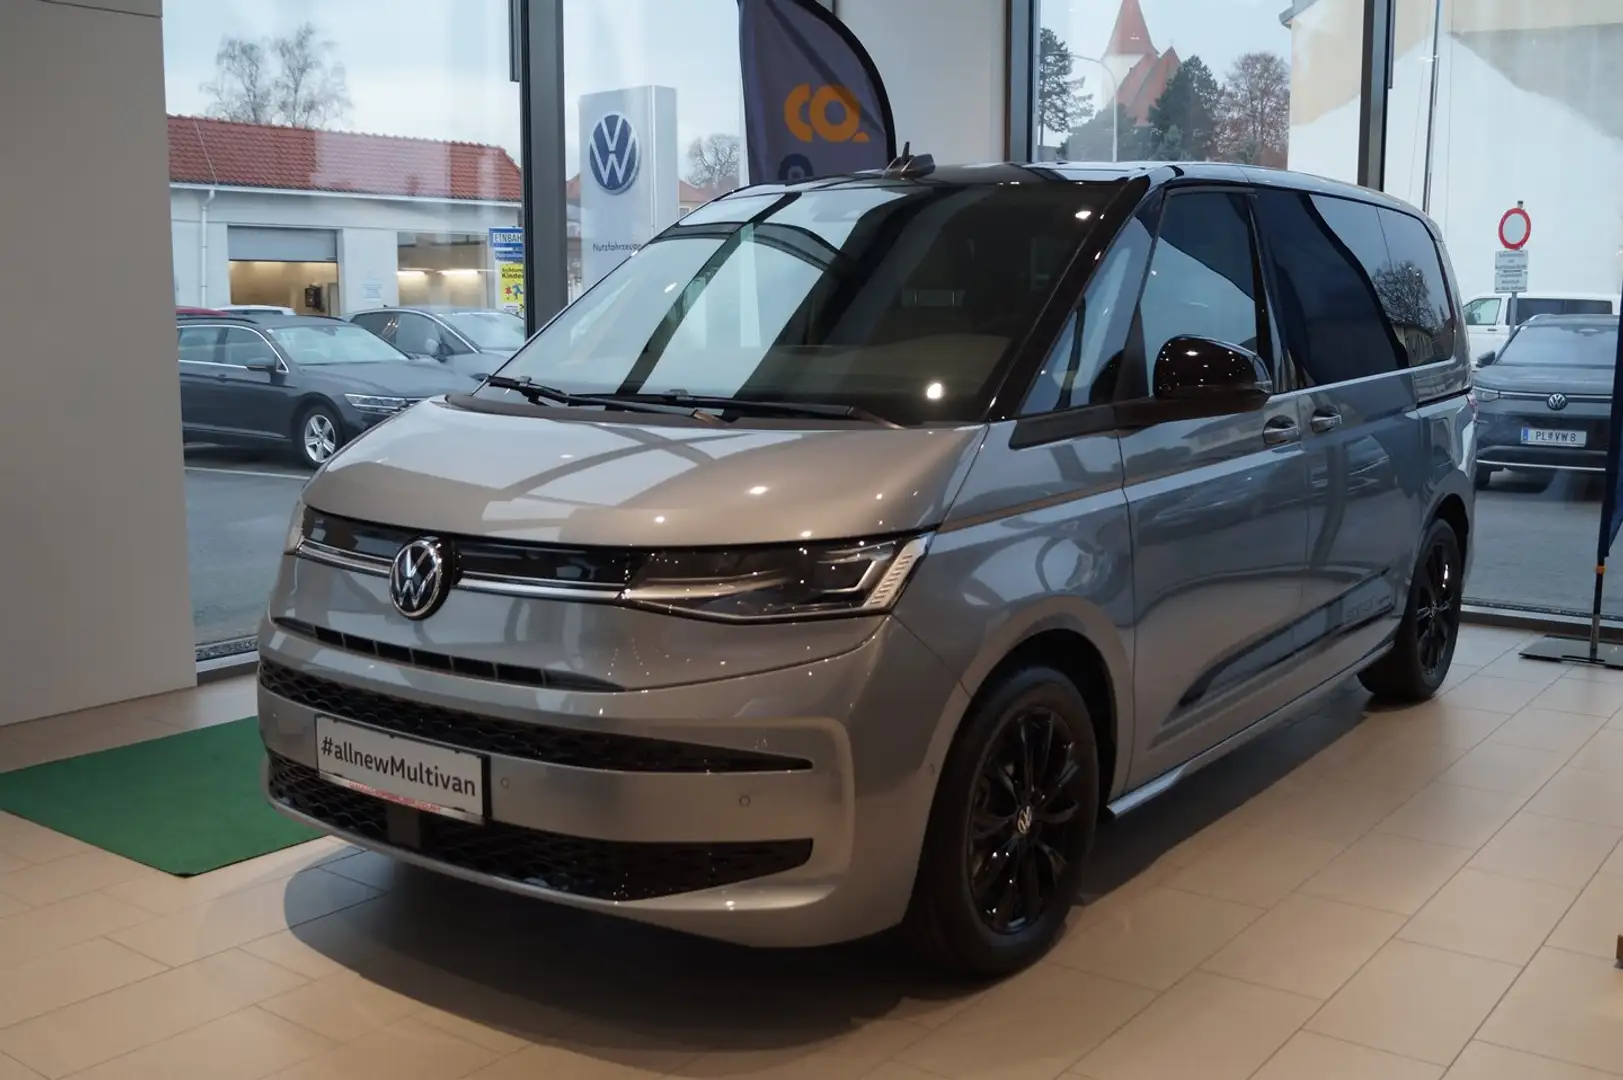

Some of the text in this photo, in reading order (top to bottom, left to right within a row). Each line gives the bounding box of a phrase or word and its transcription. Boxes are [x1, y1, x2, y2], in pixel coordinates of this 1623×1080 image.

[589, 110, 641, 195] VW
[390, 540, 442, 617] VW
[321, 736, 475, 796] #allnewMultivan
